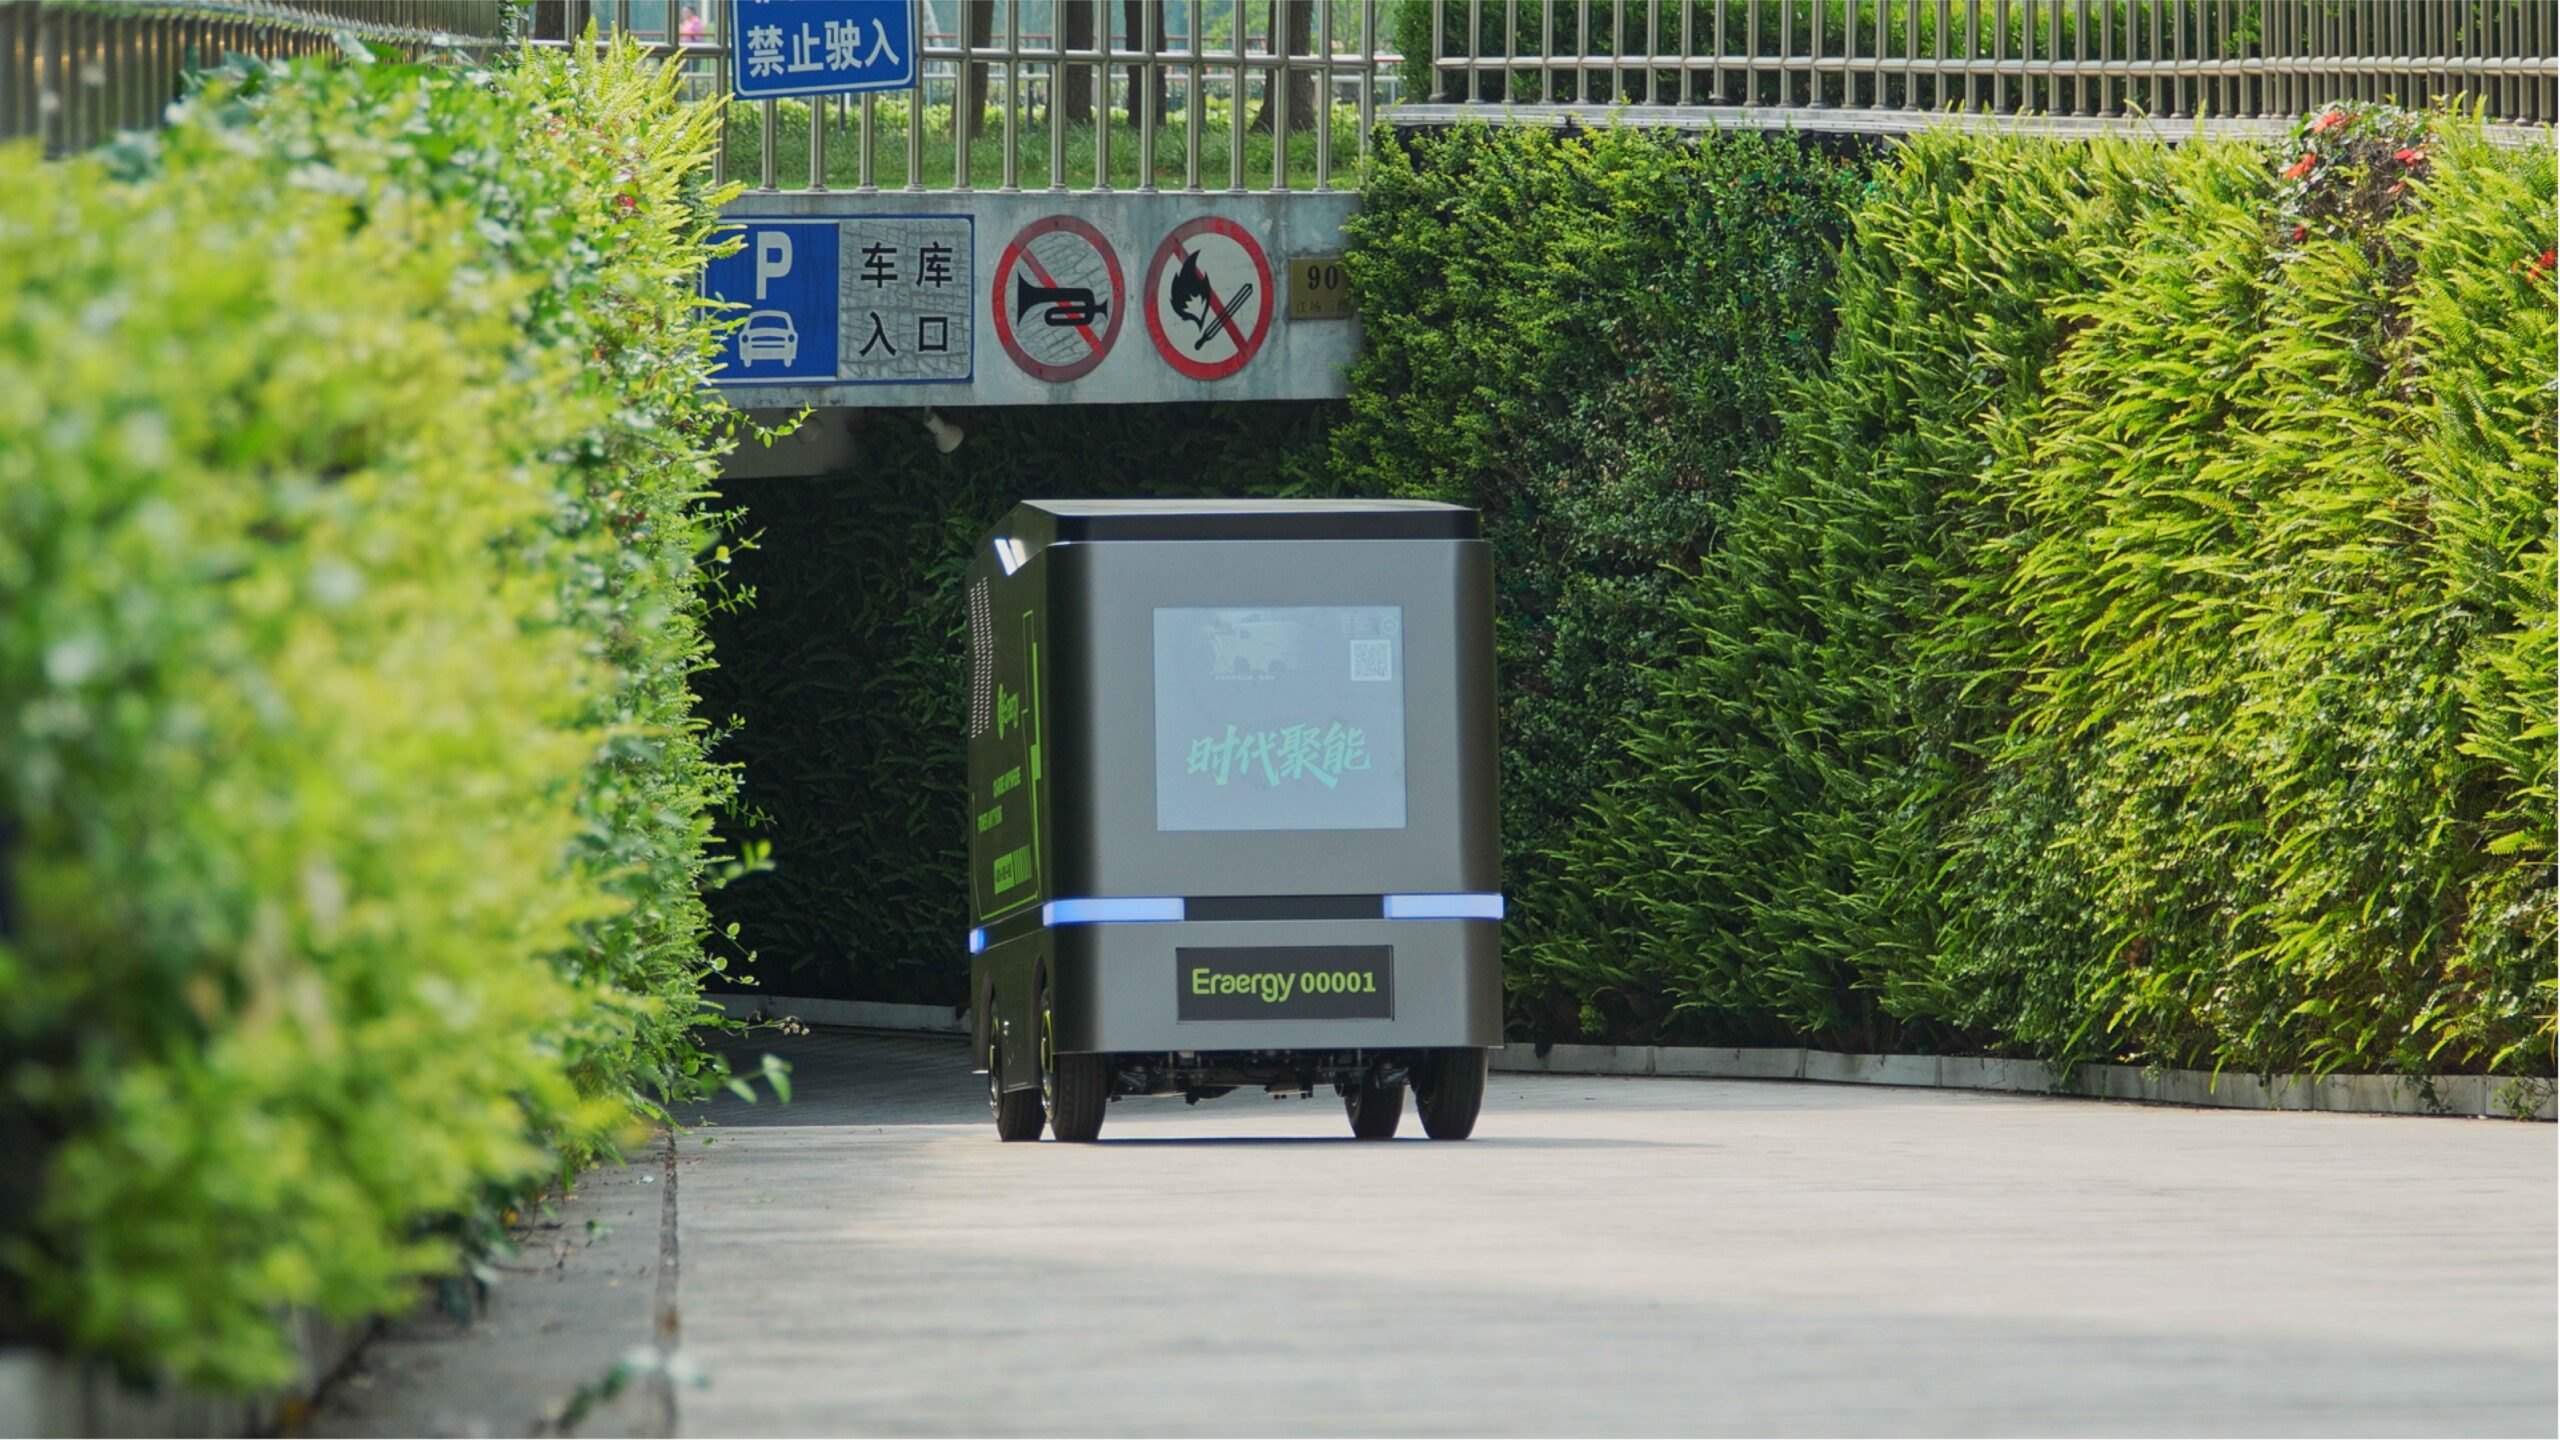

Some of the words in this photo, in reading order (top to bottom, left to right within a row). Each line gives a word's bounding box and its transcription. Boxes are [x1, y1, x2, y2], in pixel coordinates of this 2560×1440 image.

[747, 18, 900, 77] 禁止驶入
[756, 231, 793, 300] P
[860, 241, 953, 289] 车库
[1308, 264, 1339, 290] 90
[859, 311, 949, 357] 入口
[1186, 721, 1372, 789] 时代聚能
[1192, 967, 1296, 1003] Eraergy
[1300, 971, 1376, 993] 00001
